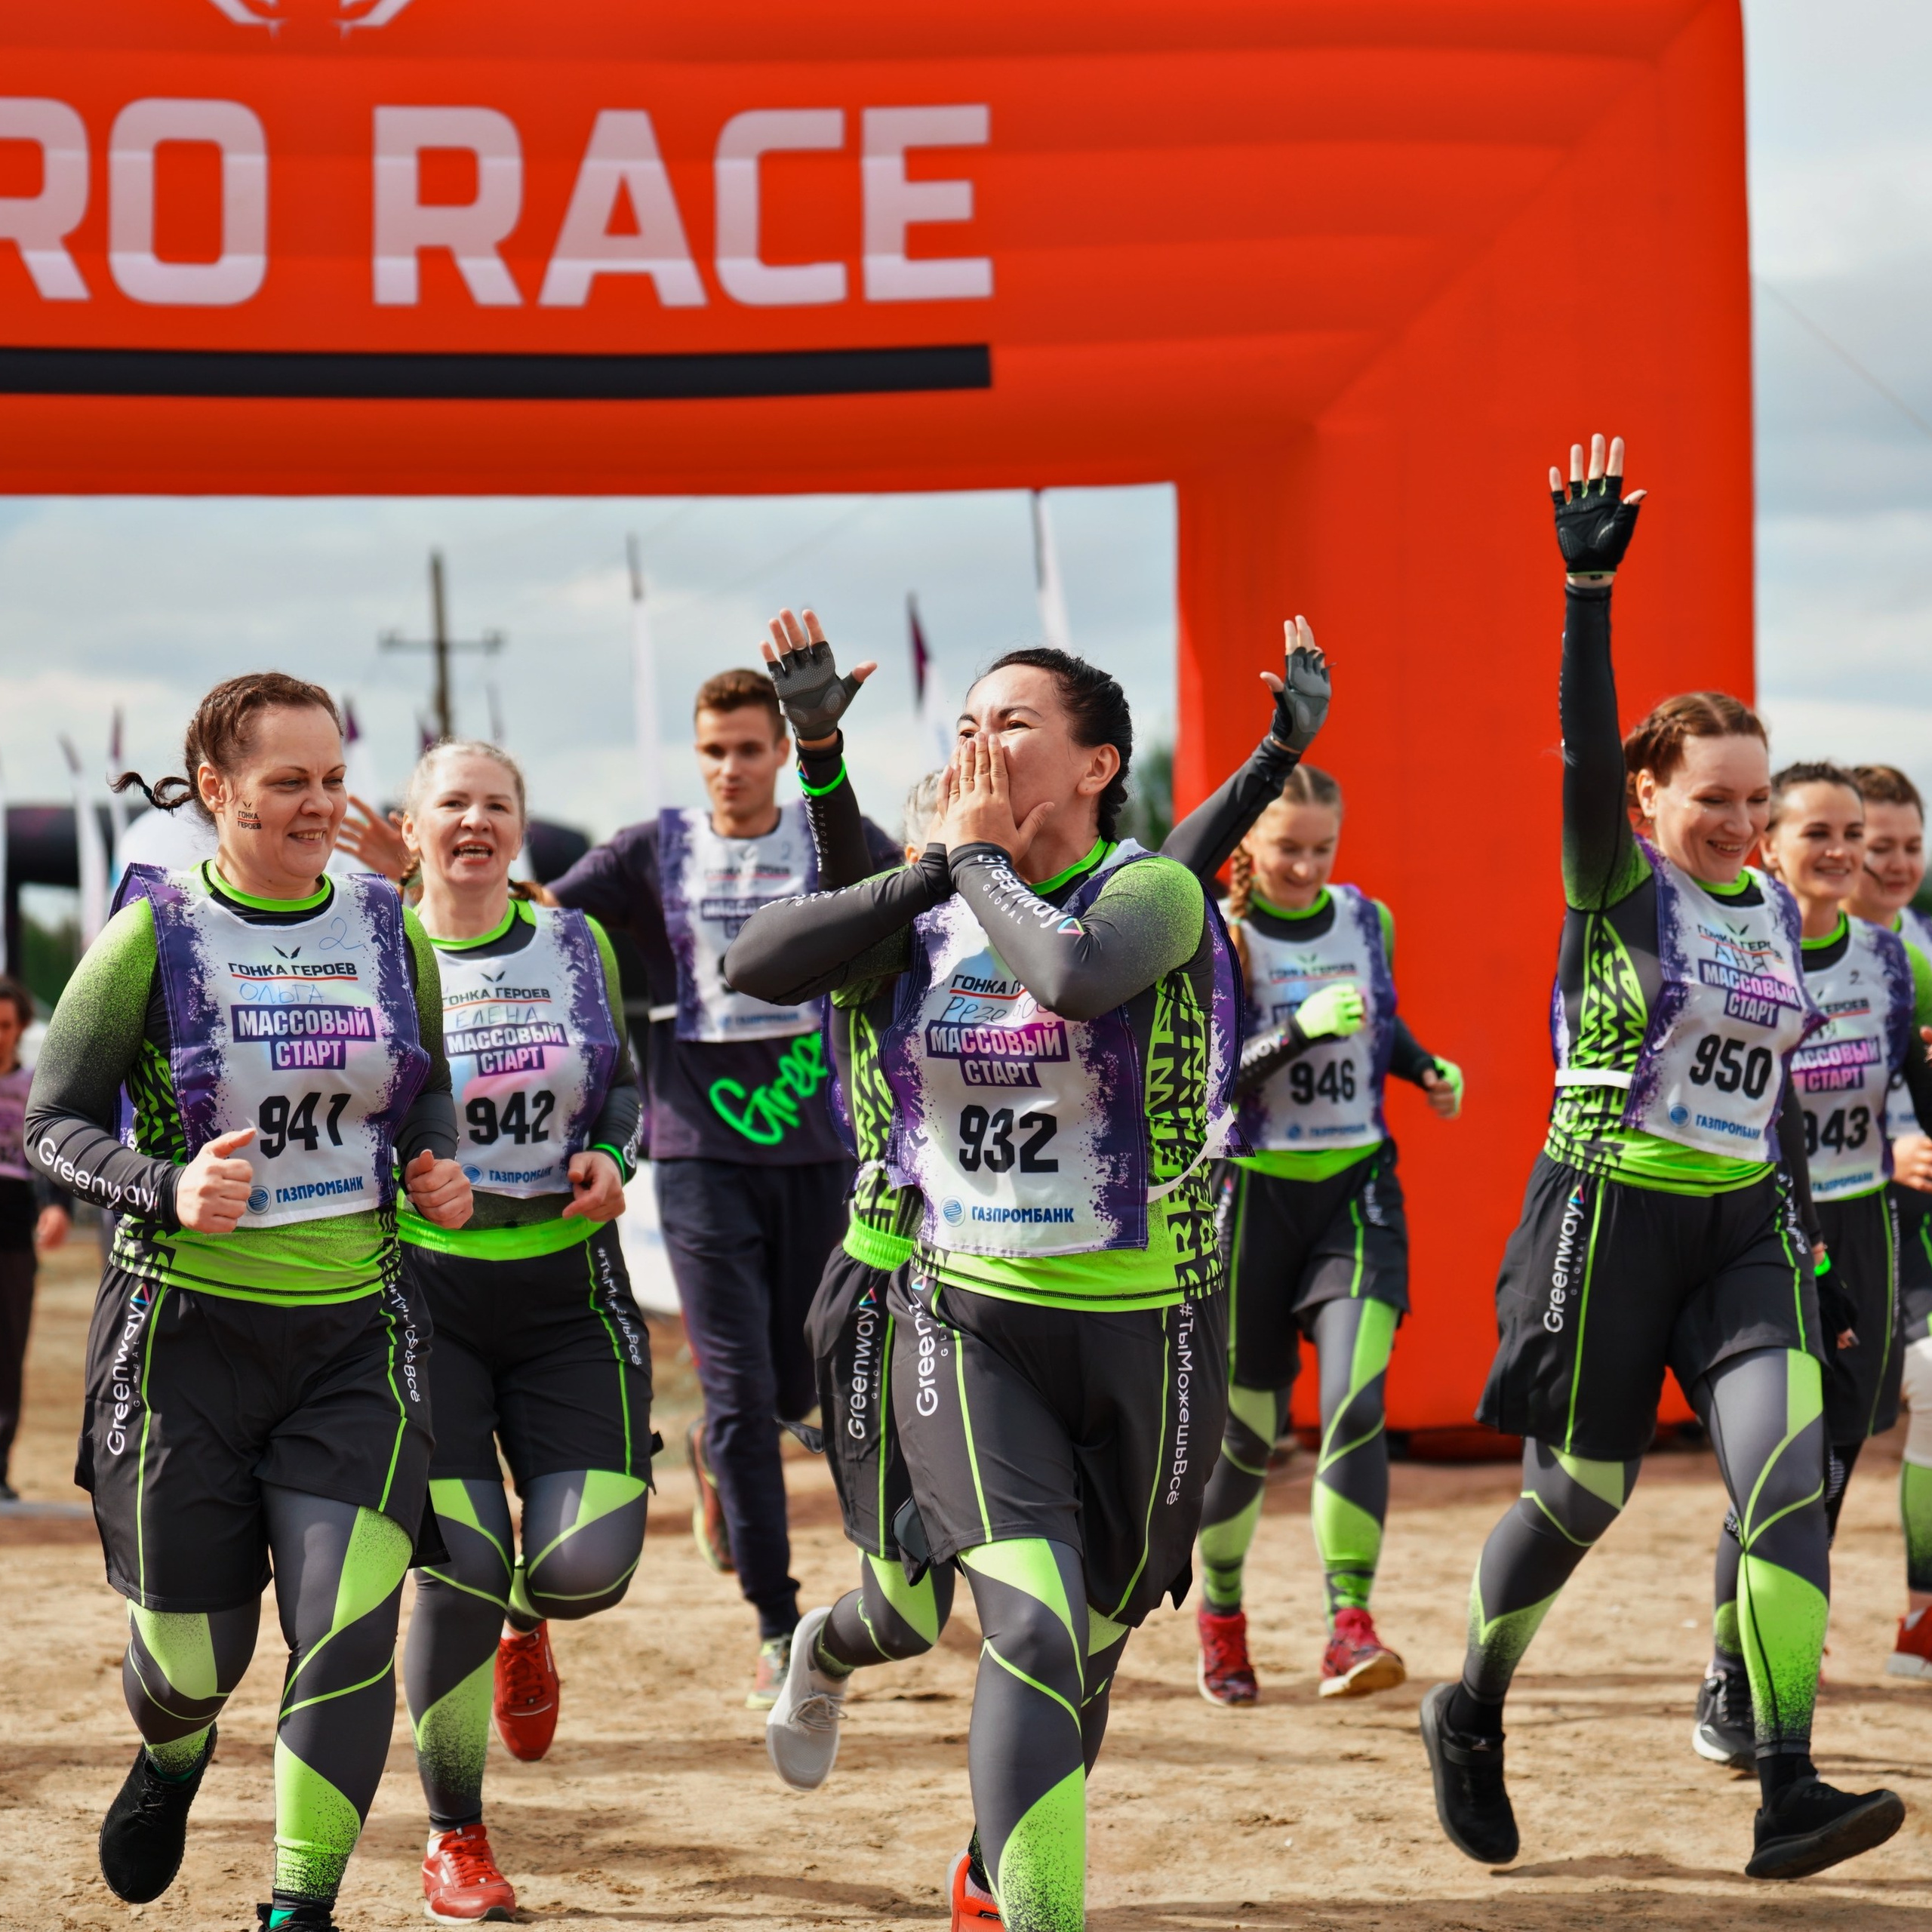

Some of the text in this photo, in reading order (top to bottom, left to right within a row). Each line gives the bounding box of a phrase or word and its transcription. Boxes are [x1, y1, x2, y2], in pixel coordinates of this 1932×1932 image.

[373, 104, 994, 308] RACE
[237, 821, 262, 829] ГЕРОЕВ
[238, 811, 259, 820] ГОНКА
[817, 805, 829, 854] GLOBAL
[983, 884, 1023, 924] GLOBAL
[318, 917, 365, 950] 2
[228, 962, 357, 976] ГОНКА ГЕРОЕВ
[952, 974, 1009, 994] ГОНКА
[239, 982, 325, 1004] ОЛЬГА
[495, 987, 551, 999] ГЕРОЕВ
[1727, 991, 1777, 1025] СТАРТ
[238, 1006, 371, 1036] МАССОВЫЙ
[456, 1005, 539, 1029] ЕЛЕНА
[275, 1040, 341, 1066] СТАРТ
[447, 1021, 564, 1054] МАССОВЫЙ
[930, 1021, 1062, 1056] МАССОВЫЙ
[480, 1047, 539, 1074] СТАРТ
[964, 1060, 1033, 1085] СТАРТ
[1689, 1034, 1773, 1100] 950
[1790, 1040, 1879, 1072] АССОВЫЙ
[1290, 1058, 1355, 1106] 946
[1807, 1066, 1862, 1092] СТАРТ
[259, 1092, 352, 1159] 941
[466, 1090, 555, 1145] 942
[958, 1104, 1059, 1174] 932
[275, 1176, 364, 1203] ГАЗПРОМБАНК
[971, 1206, 1075, 1223] ГАЗПРОМБАНК
[1543, 1202, 1584, 1333] Greenway
[106, 1301, 146, 1456] Greenway
[132, 1339, 141, 1407] GLOBAL
[848, 1306, 880, 1440] Greenway
[1166, 1302, 1195, 1506] #ТыМожешьВсё
